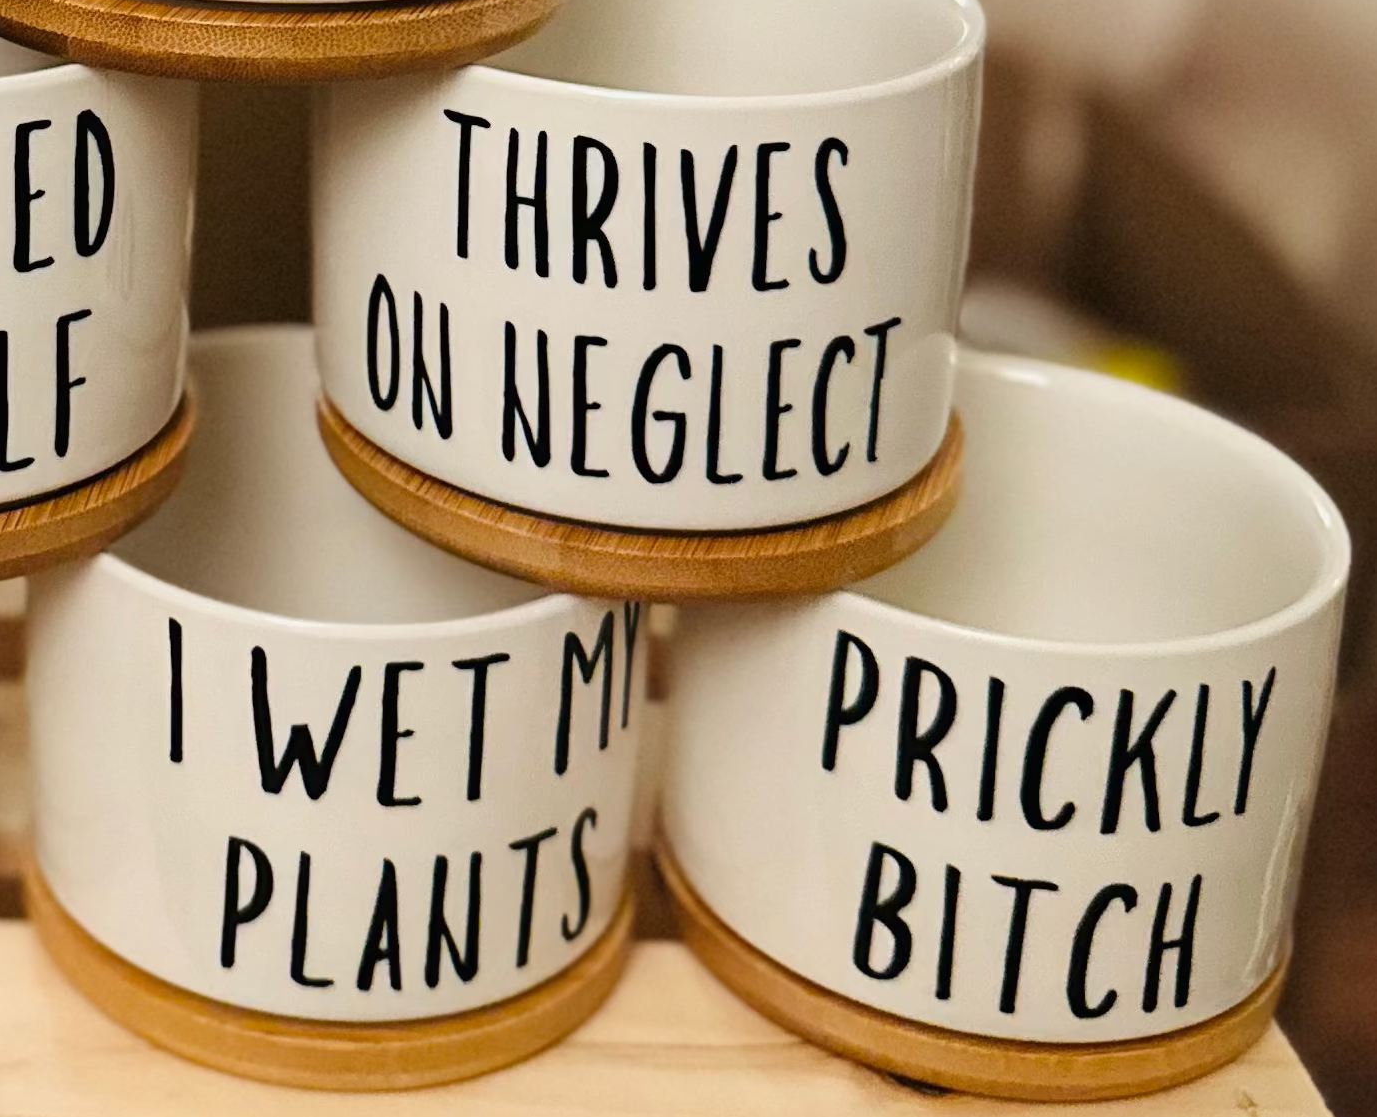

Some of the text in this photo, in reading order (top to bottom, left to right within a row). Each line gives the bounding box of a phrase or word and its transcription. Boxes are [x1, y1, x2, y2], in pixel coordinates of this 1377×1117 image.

[443, 108, 849, 293] THRIVES
[366, 273, 902, 485] ON NEGLECT
[168, 600, 641, 808] I WET MY
[821, 629, 1278, 835] PRICKLY
[220, 807, 598, 992] PLANTS
[853, 842, 1203, 1021] BITCH
